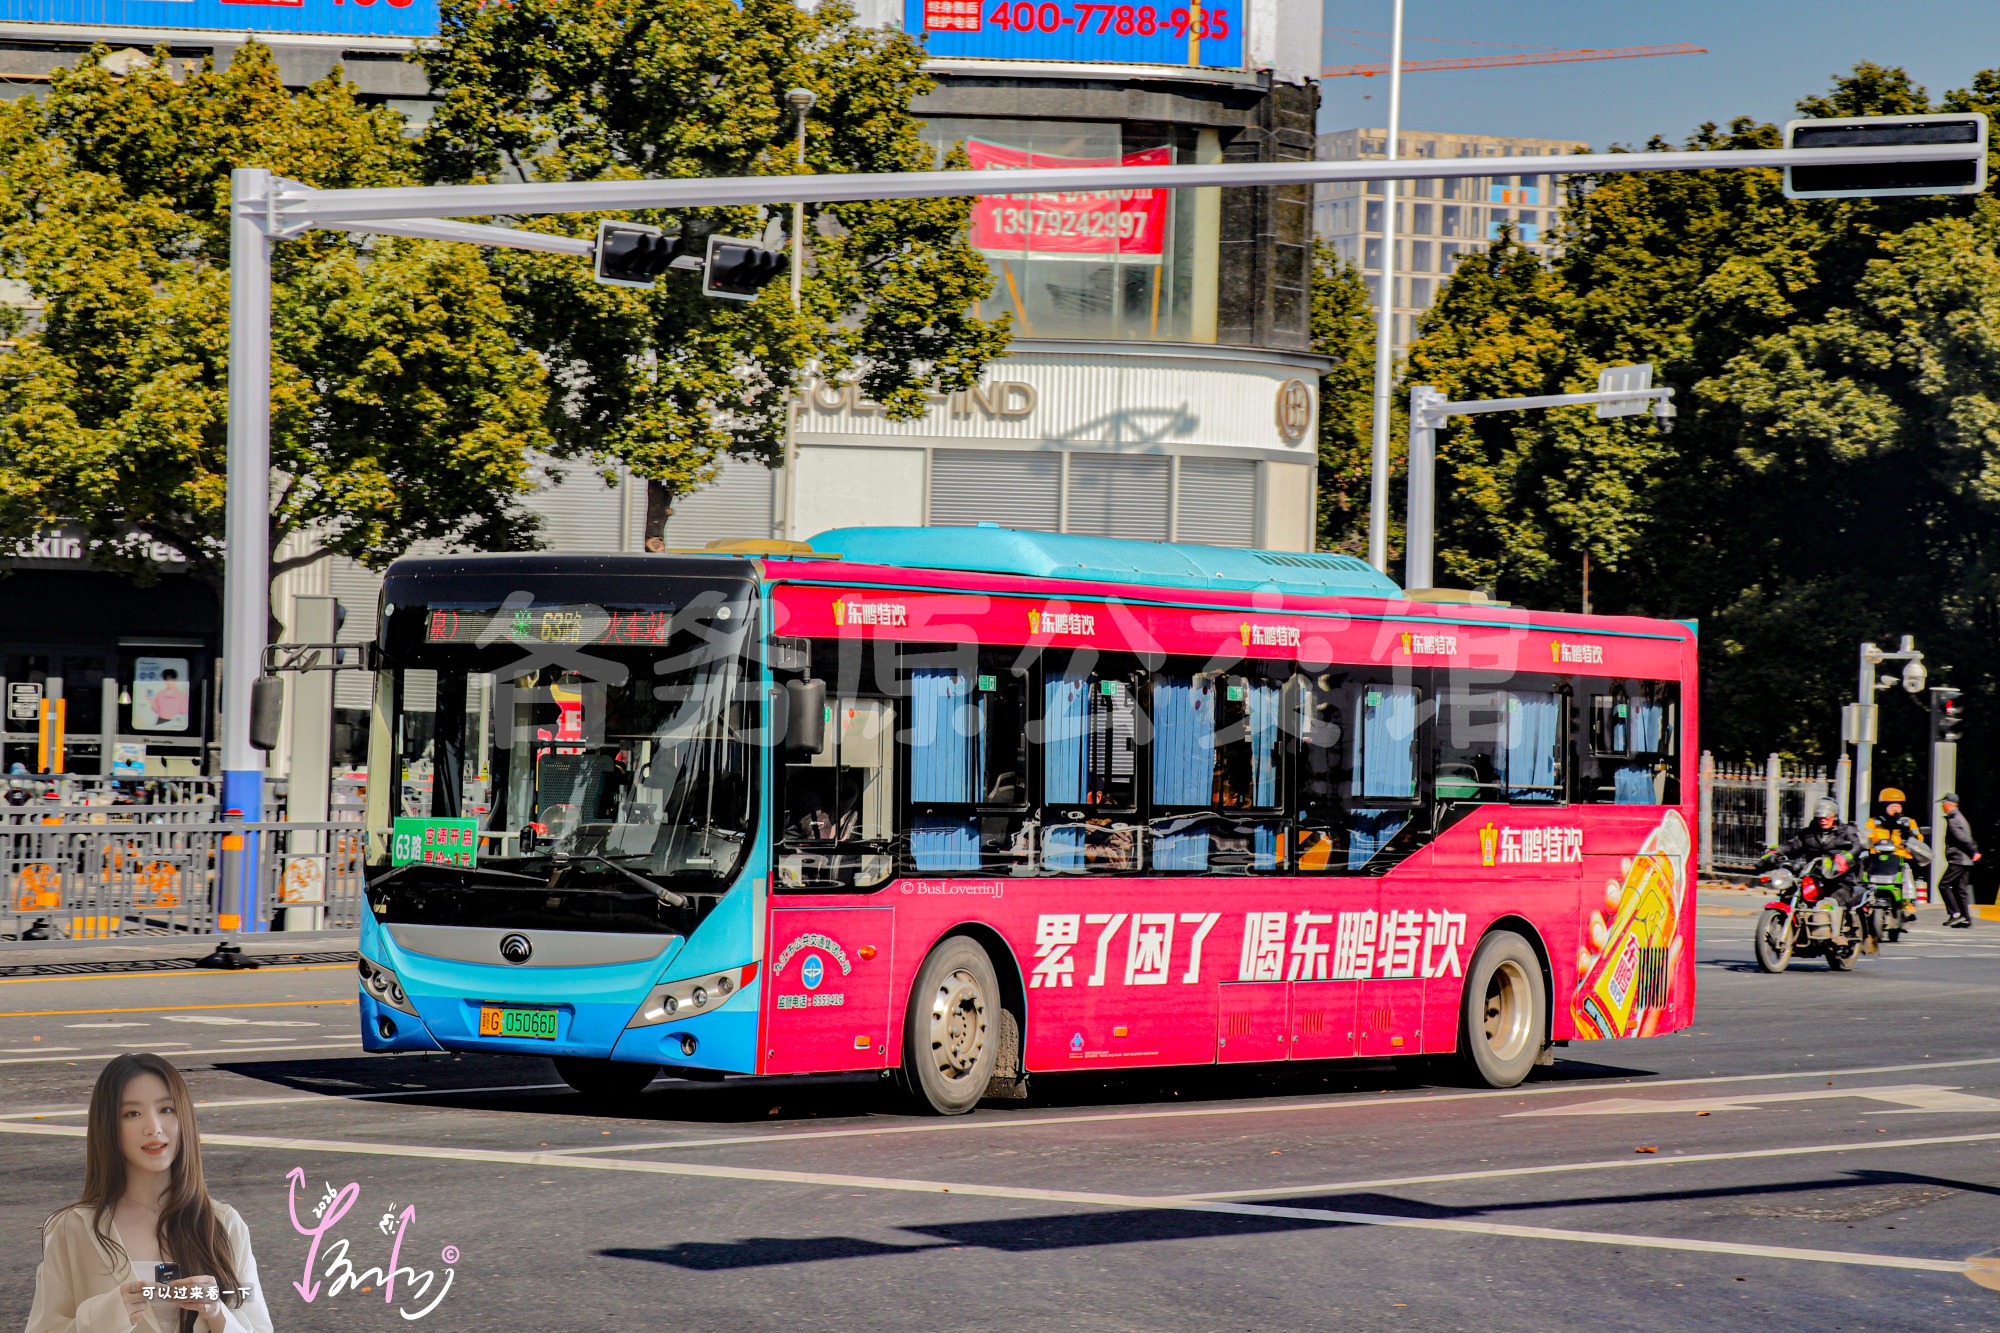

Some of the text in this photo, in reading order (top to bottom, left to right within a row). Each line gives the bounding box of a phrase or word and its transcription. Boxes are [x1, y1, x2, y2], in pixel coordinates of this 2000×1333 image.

[991, 207, 1148, 239] 13979242997
[847, 601, 907, 627] 东鹏特饮
[1041, 611, 1096, 636] 东鹏特饮
[601, 611, 668, 644] 火车站
[1251, 623, 1301, 648] 东鹏特饮
[1412, 632, 1458, 656] 东鹏特饮
[1560, 640, 1604, 664] 东鹏特饮
[395, 833, 423, 861] 63路
[425, 827, 473, 847] 空调开启
[1500, 826, 1584, 863] 东鹏特饮
[1029, 907, 1468, 989] 累了困了 喝东鹏特饮
